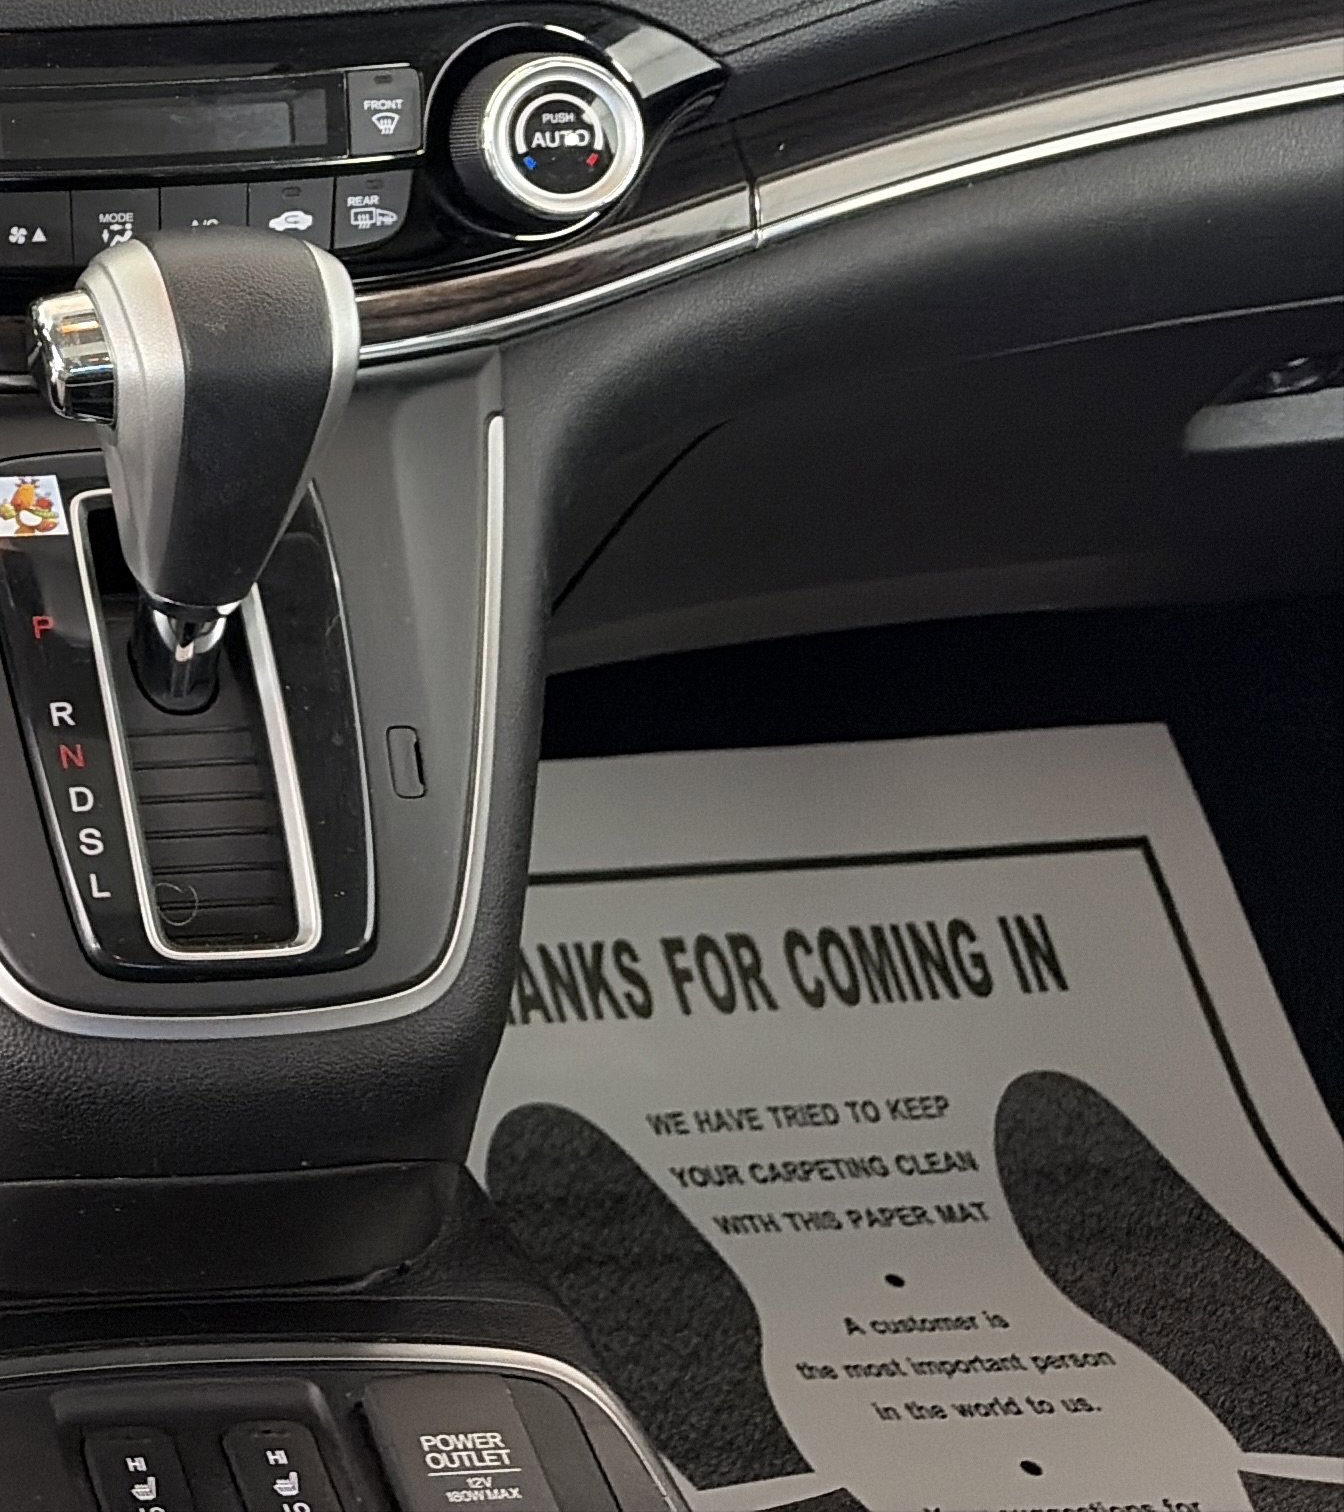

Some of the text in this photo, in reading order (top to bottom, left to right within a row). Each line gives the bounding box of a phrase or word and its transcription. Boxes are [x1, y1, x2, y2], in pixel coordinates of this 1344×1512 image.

[363, 99, 404, 111] FRONT
[542, 111, 575, 125] PUSH
[530, 128, 591, 149] AUTO
[347, 195, 380, 207] REAR
[98, 212, 134, 224] MODE
[32, 616, 55, 639] P
[50, 702, 75, 727] R
[58, 743, 86, 769] N
[69, 786, 94, 813] D
[79, 828, 104, 856] S
[89, 873, 112, 900] L
[509, 912, 1069, 1025] ANKS FOR COMING IN
[645, 1095, 950, 1136] WE HAVE TRIED TO KEEP
[669, 1150, 979, 1188] YOUR CARPETING CLEAN
[712, 1201, 990, 1236] WITH THIS PAPER MAT
[844, 1310, 1010, 1335] A customer is
[796, 1350, 1116, 1379] the most important person
[872, 1395, 1102, 1421] in the world to us.
[419, 1432, 506, 1451] POWER
[125, 1456, 148, 1472] HI
[266, 1449, 289, 1465] HI
[425, 1449, 511, 1469] OUTLET
[465, 1476, 492, 1488] 12V
[445, 1487, 523, 1503] 180W MAX
